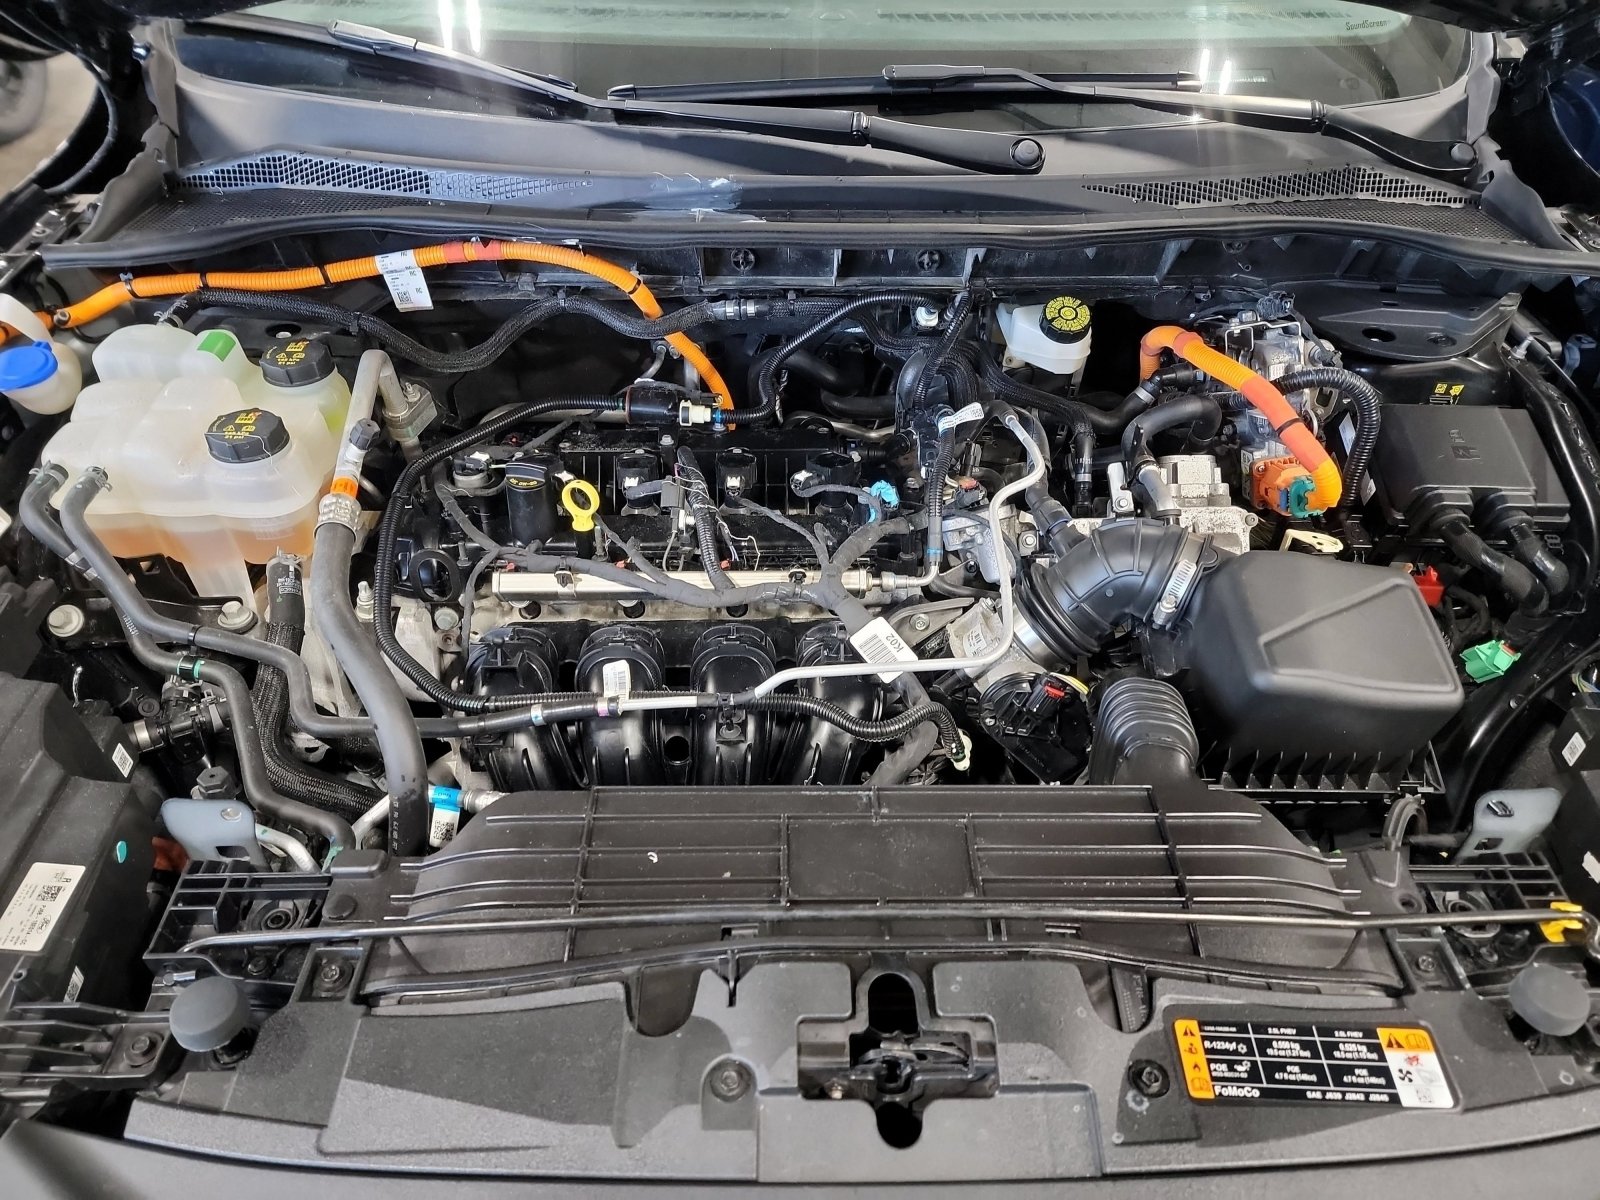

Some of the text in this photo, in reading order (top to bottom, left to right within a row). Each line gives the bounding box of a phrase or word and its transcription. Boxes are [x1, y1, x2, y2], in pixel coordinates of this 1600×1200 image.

[1345, 20, 1388, 30] SoundScreen
[885, 632, 904, 653] K02
[1204, 1040, 1237, 1052] R-1234yf
[1290, 1041, 1300, 1050] kg
[1357, 1044, 1367, 1053] kg
[1210, 1063, 1228, 1072] POE
[1214, 1085, 1260, 1098] FoMoCo
[1306, 1090, 1323, 1100] SAE
